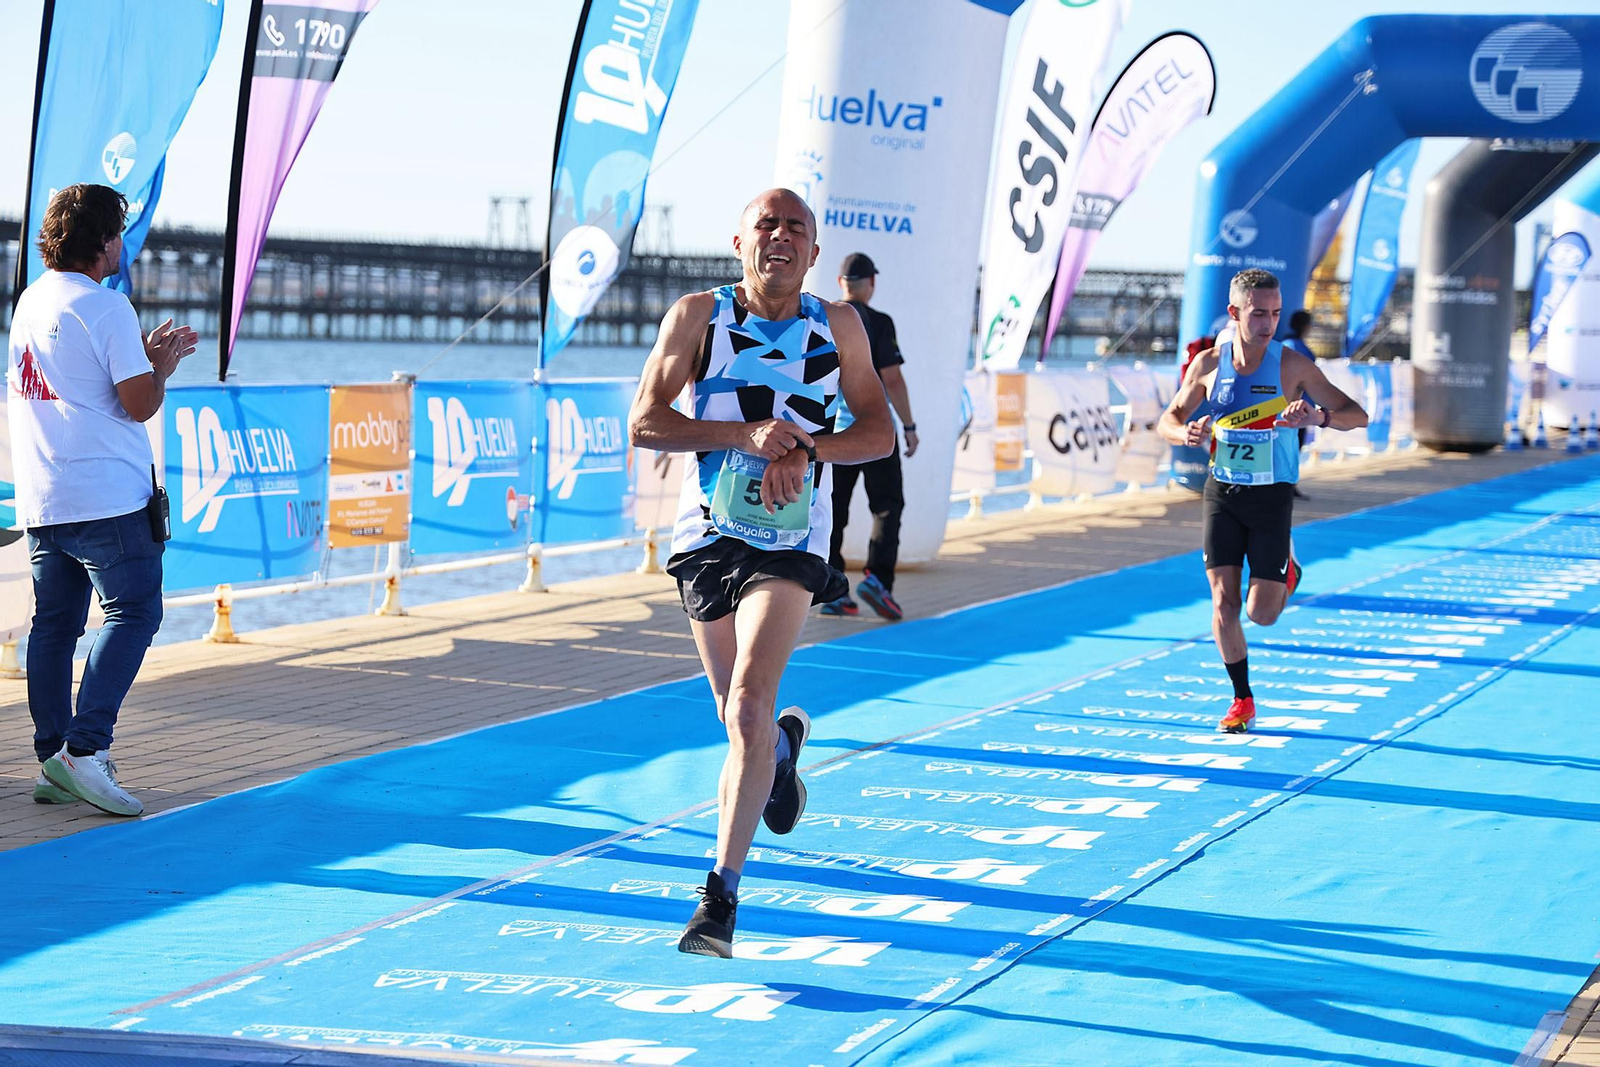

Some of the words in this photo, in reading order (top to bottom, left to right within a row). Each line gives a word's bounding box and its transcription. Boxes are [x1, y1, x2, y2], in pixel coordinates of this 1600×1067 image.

[295, 18, 346, 50] 1790
[608, 0, 656, 54] HU
[1097, 58, 1194, 165] AVATEL
[871, 134, 925, 150] original
[1009, 56, 1076, 253] CSIF
[824, 209, 914, 235] HUELVA
[1230, 408, 1259, 426] CLUB
[470, 417, 519, 457] HUELVA
[581, 416, 623, 455] HUELVA
[225, 428, 297, 475] HUELVA
[742, 458, 765, 470] HUELVA
[1227, 443, 1255, 461] 72
[727, 518, 771, 540] Wayalia
[925, 762, 1098, 783] HUELVA
[861, 787, 1037, 808] HUELVA
[1033, 797, 1161, 819] 10
[970, 825, 1106, 850] 10
[898, 857, 1044, 886] 10
[609, 882, 829, 908] HULVA
[815, 894, 972, 922] 10
[498, 924, 686, 947] UELVA
[373, 974, 634, 1003] HUELVA
[614, 982, 801, 1022] 10
